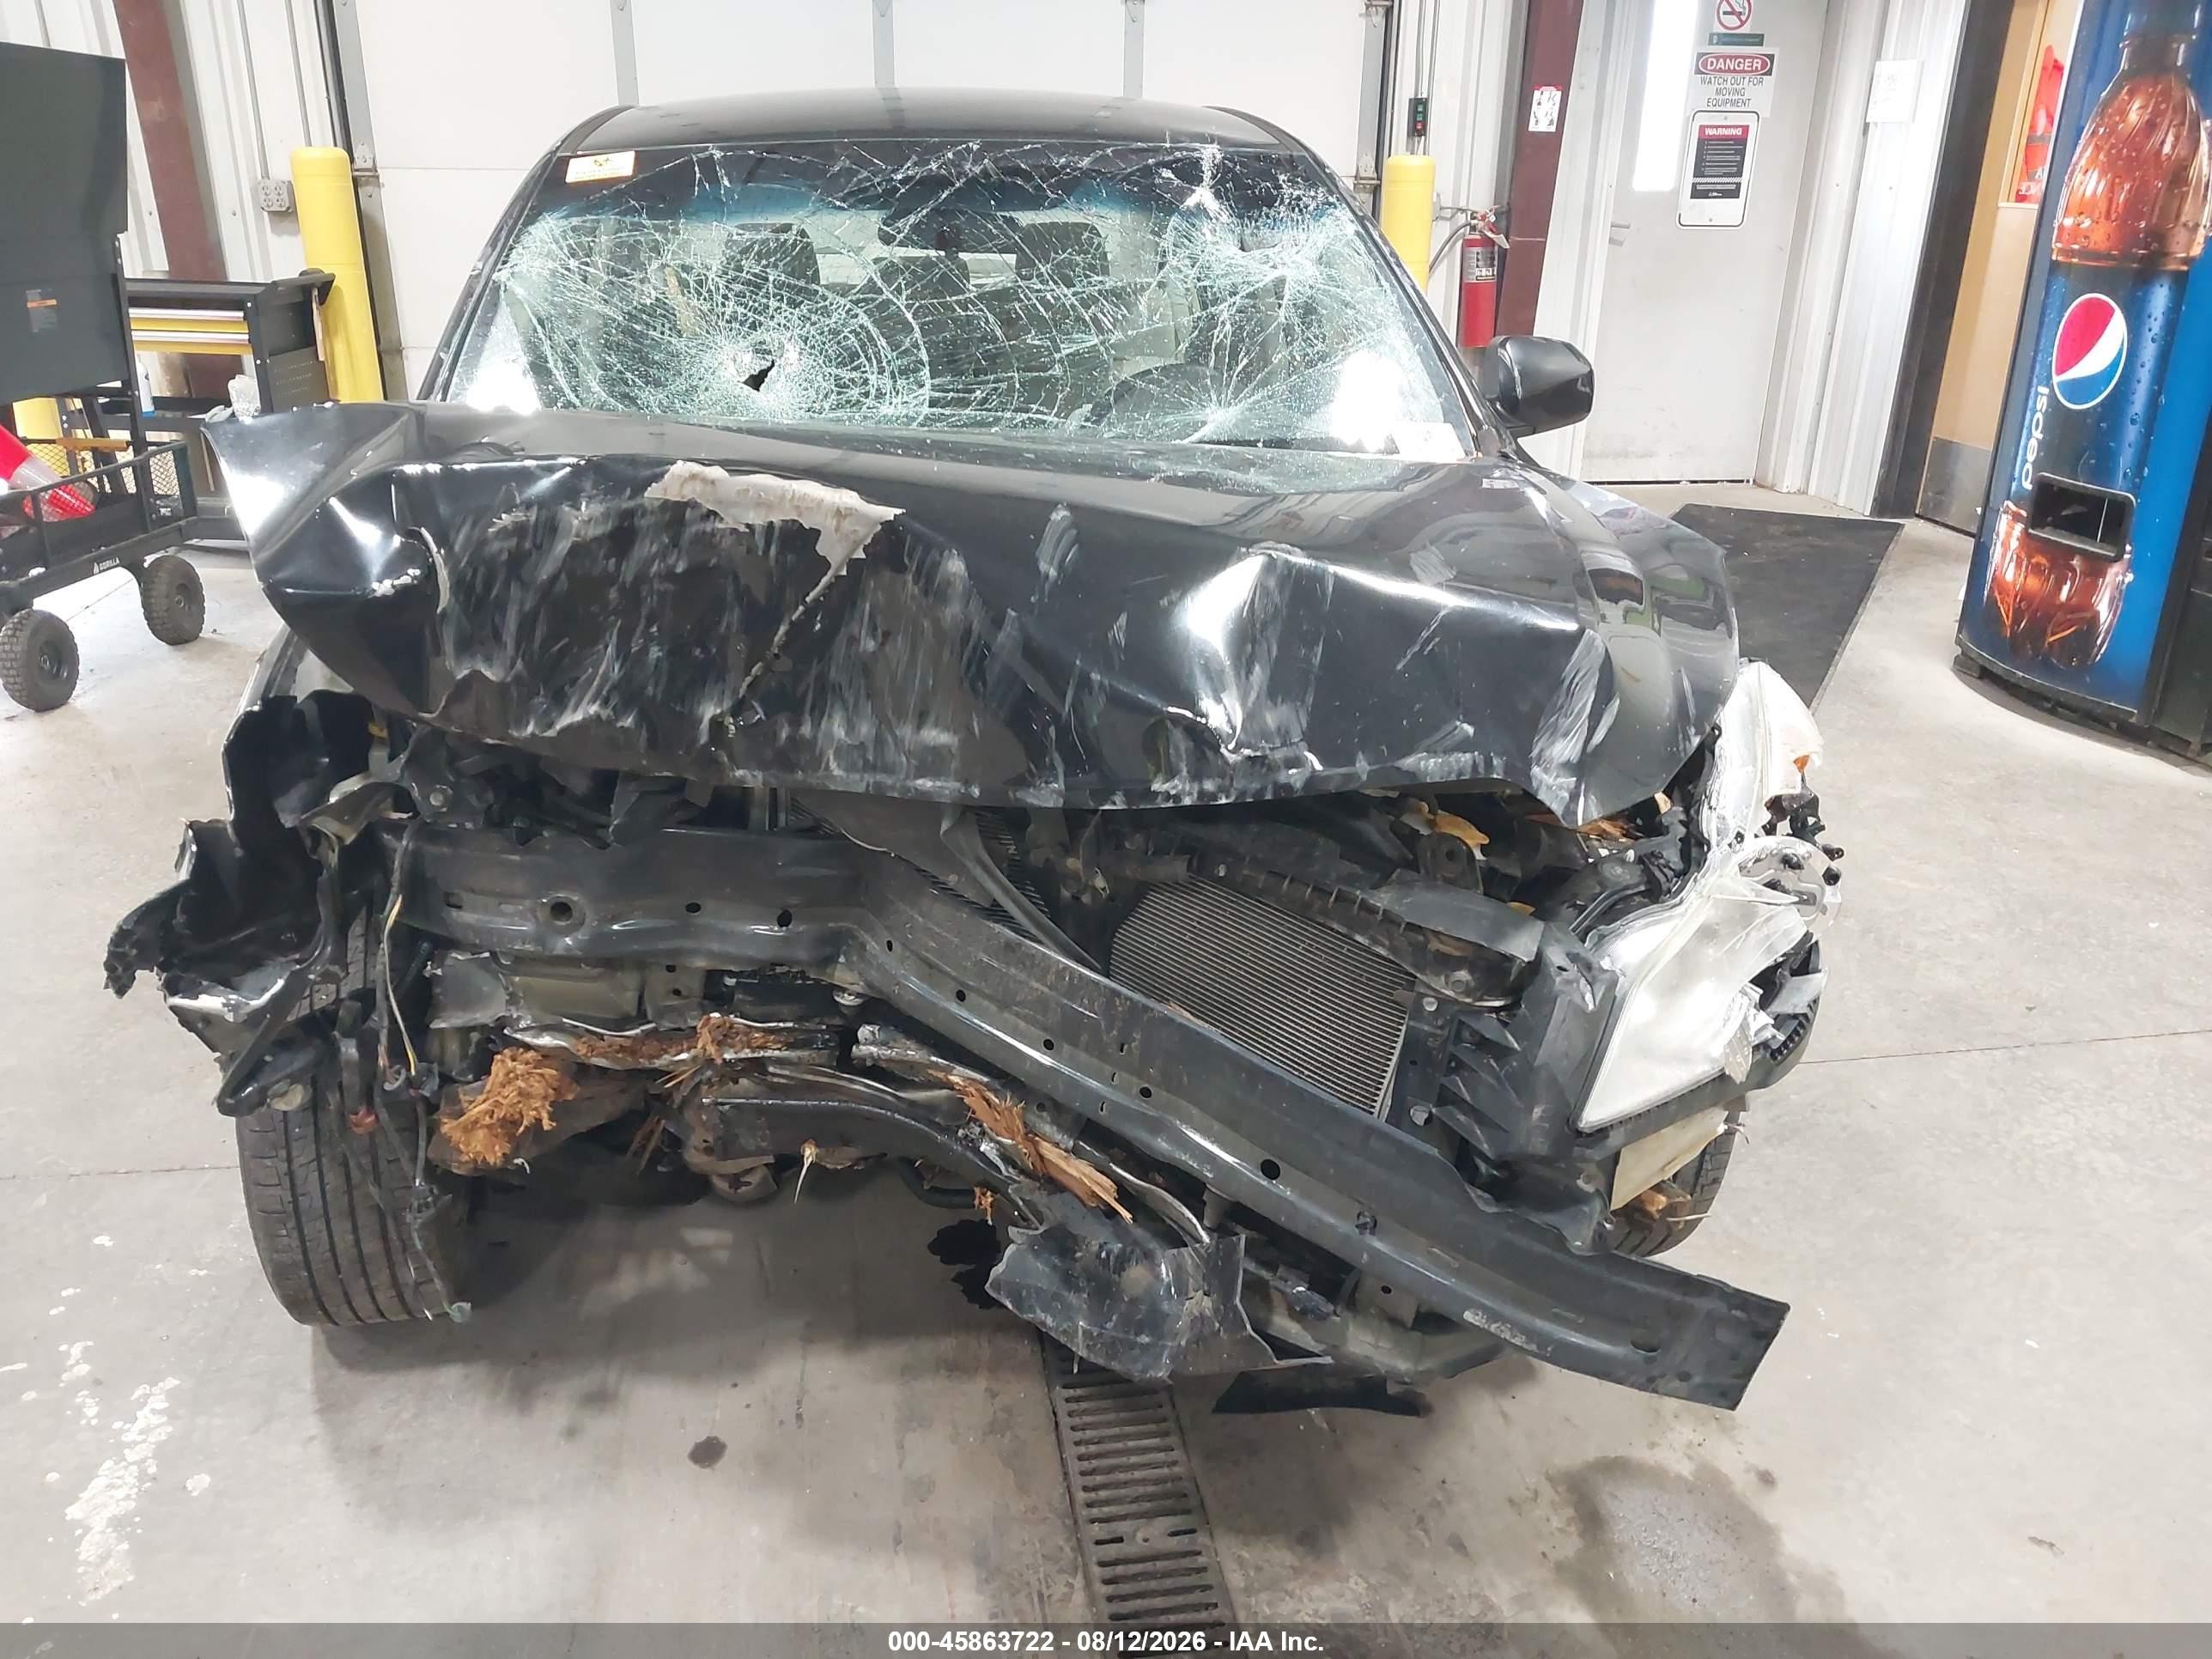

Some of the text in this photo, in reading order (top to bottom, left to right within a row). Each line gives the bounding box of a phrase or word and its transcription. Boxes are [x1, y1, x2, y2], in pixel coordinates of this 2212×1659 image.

[1707, 58, 1762, 71] DANGER
[1700, 76, 1764, 87] WATCH OUT FOR
[1715, 87, 1746, 97] MOVING
[1706, 98, 1752, 108] EQUIPMENT
[1705, 127, 1742, 136] WARNING
[2021, 385, 2050, 490] pepsi
